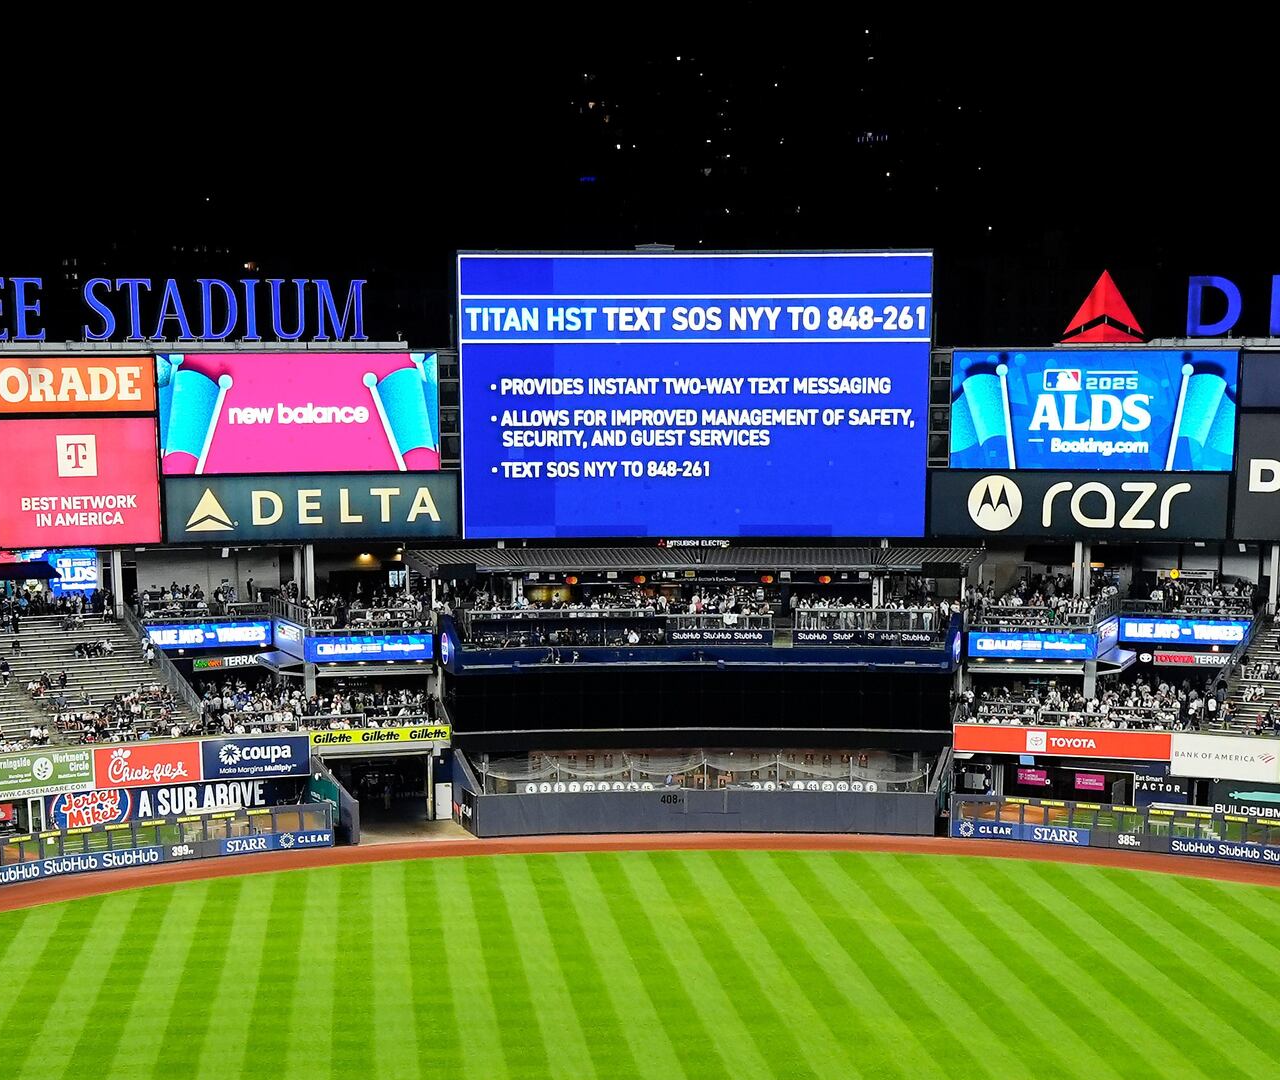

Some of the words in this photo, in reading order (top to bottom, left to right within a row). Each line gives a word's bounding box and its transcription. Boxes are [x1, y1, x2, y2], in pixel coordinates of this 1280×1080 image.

[83, 278, 368, 340] STADIUM
[466, 308, 540, 331] TITAN
[547, 308, 596, 331] HST
[602, 307, 666, 331] TEXT
[671, 306, 721, 331] SOS
[729, 307, 780, 331] NYY
[787, 306, 820, 330] TO
[827, 306, 925, 330] 848-261
[501, 378, 584, 395] PROVIDES
[589, 378, 659, 394] INSTANT
[663, 378, 743, 394] TWO-WAY
[748, 378, 790, 394] TEXT
[794, 377, 891, 394] MESSAGING
[1086, 378, 1138, 390] 2025
[228, 407, 274, 424] new
[278, 403, 369, 424] balance
[501, 411, 570, 426] ALLOWS
[574, 410, 607, 426] FOR
[611, 410, 695, 426] IMPROVED
[702, 409, 819, 425] MANAGEMENT
[822, 409, 844, 425] OF
[848, 409, 915, 428] SAFETY,
[1029, 394, 1151, 432] ALDS
[503, 431, 587, 449] SECURITY,
[591, 430, 626, 446] AND
[630, 430, 684, 446] GUEST
[689, 430, 770, 446] SERVICES
[1051, 438, 1148, 456] Booking.com
[501, 462, 543, 478] TEXT
[546, 462, 580, 478] SOS
[584, 462, 617, 477] NYY
[621, 462, 644, 477] TO
[647, 461, 710, 477] 848-261
[21, 497, 57, 512] BEST
[61, 495, 136, 511] NETWORK
[252, 487, 440, 526] DELTA
[1042, 482, 1191, 529] razr
[36, 513, 50, 527] IN
[54, 512, 124, 527] AMERICA
[314, 733, 352, 744] Gillette
[362, 731, 400, 741] Gillette
[410, 729, 447, 740] Gillette
[1050, 738, 1096, 748] TOYOTA
[53, 751, 89, 762] Workmen's
[242, 745, 291, 762] coupa
[1175, 751, 1199, 759] BANK
[1215, 753, 1254, 762] AMERICA
[69, 762, 89, 772] Circle
[108, 755, 187, 783] Chick-fil-A
[61, 789, 120, 811] Jersey
[138, 791, 152, 818] A
[158, 787, 198, 815] SUB
[199, 781, 268, 809] ABOVE
[660, 795, 678, 804] 408
[68, 805, 121, 828] Mike's
[298, 834, 330, 844] CLEAR
[979, 826, 1011, 835] CLEAR
[1034, 829, 1078, 843] STARR
[227, 837, 266, 852] STARR
[1172, 841, 1215, 854] StubHub
[1219, 845, 1259, 858] StubHub
[44, 857, 97, 875] StubHub
[103, 850, 158, 867] StubHub
